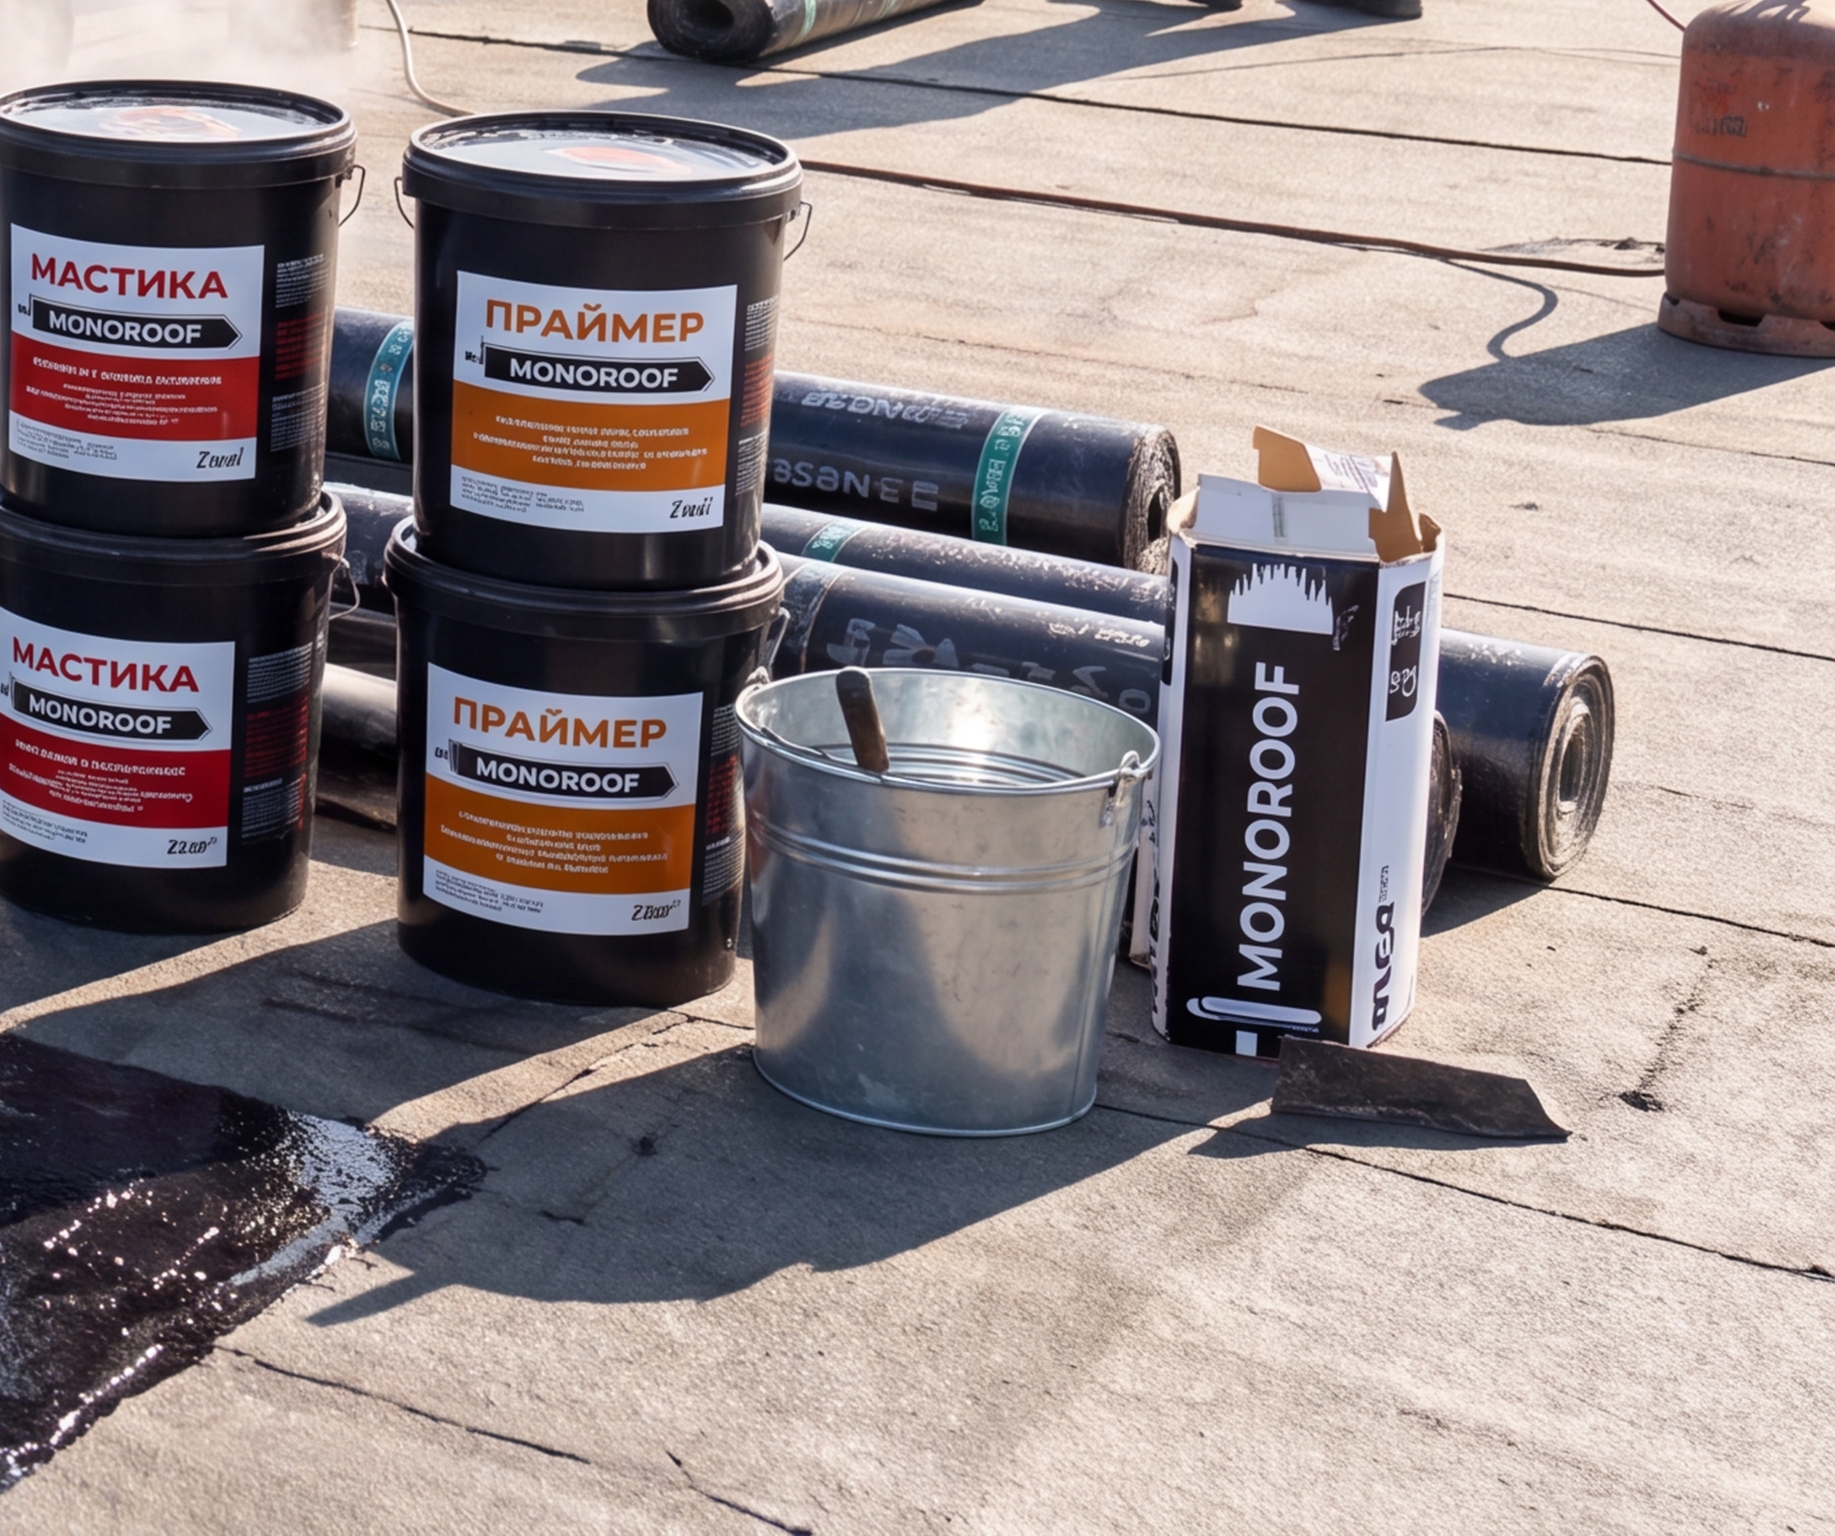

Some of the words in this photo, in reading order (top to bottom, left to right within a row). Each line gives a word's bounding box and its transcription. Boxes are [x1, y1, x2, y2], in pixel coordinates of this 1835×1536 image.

[31, 252, 229, 300] МАСТИКА
[49, 310, 202, 344] MONOROOF
[486, 298, 705, 344] ПРАЙМЕР
[509, 357, 679, 389] MONOROOF
[12, 635, 200, 693] МАСТИКА
[29, 693, 172, 735] MONOROOF
[453, 696, 668, 749] ПРАЙМЕР
[476, 756, 640, 794] MONOROOF
[1236, 661, 1301, 992] MONOROOF
